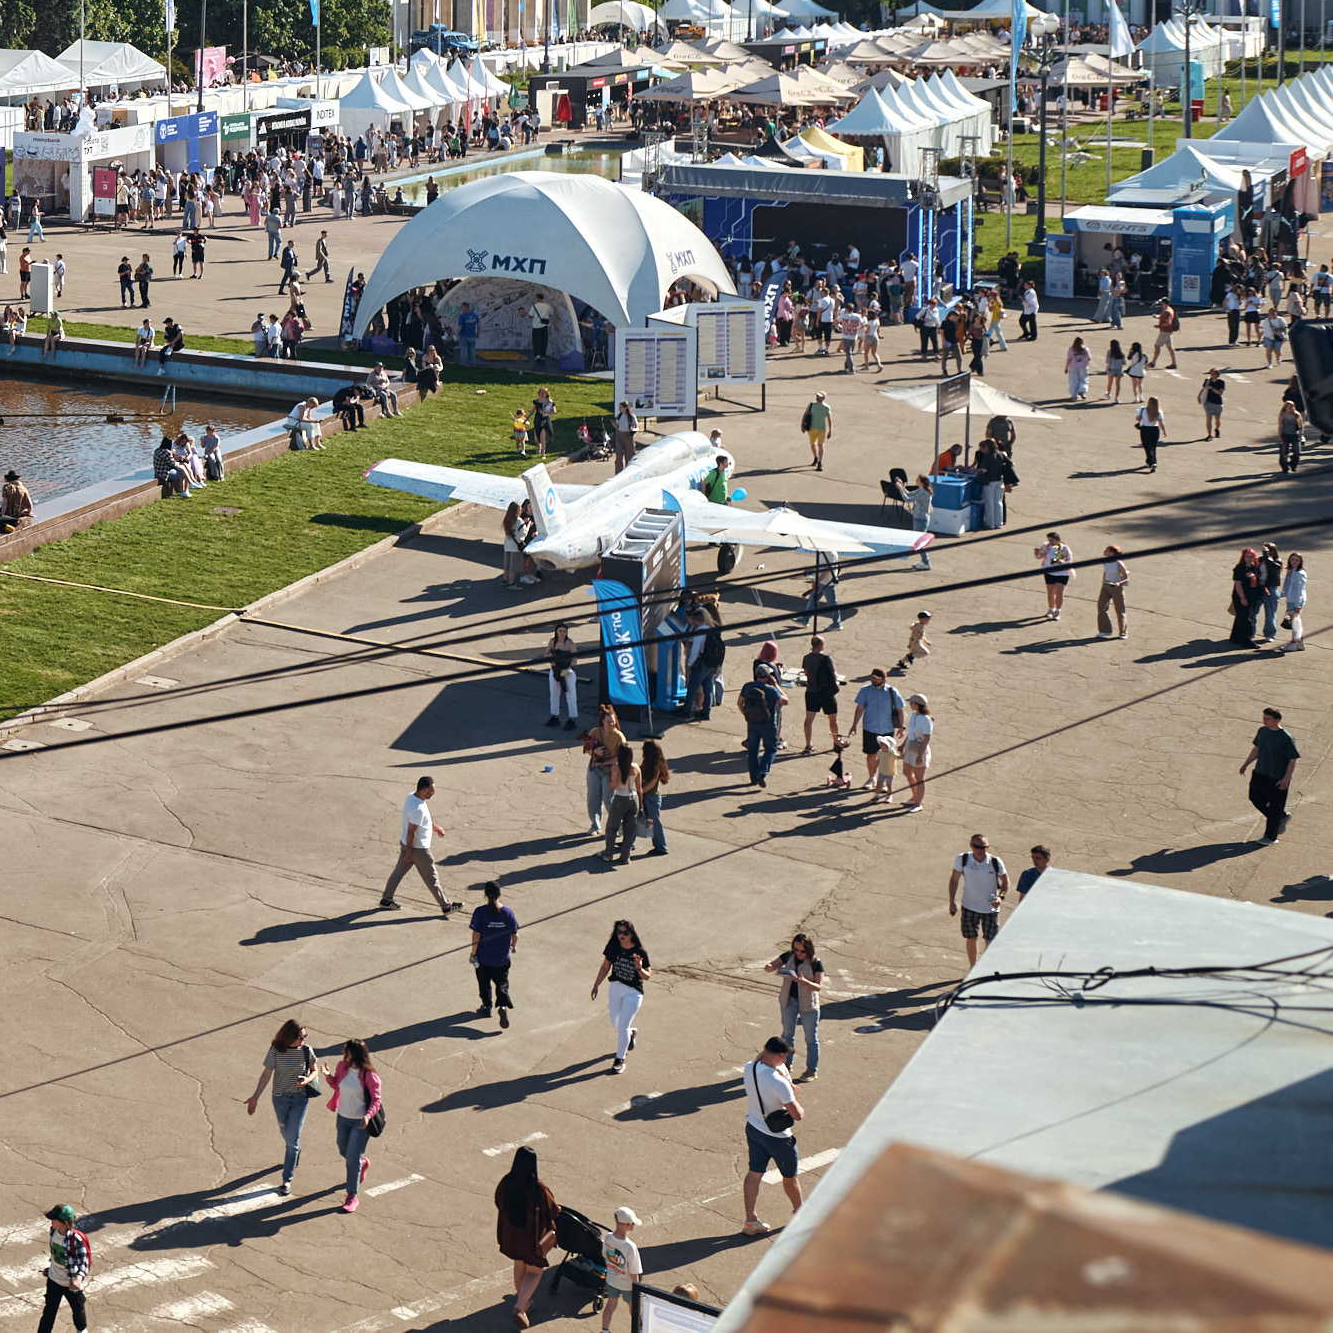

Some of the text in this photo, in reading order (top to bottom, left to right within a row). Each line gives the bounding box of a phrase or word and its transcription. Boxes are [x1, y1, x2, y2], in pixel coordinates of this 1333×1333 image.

[1103, 223, 1148, 233] VENTS
[491, 254, 547, 275] МХП
[673, 250, 696, 268] МХП
